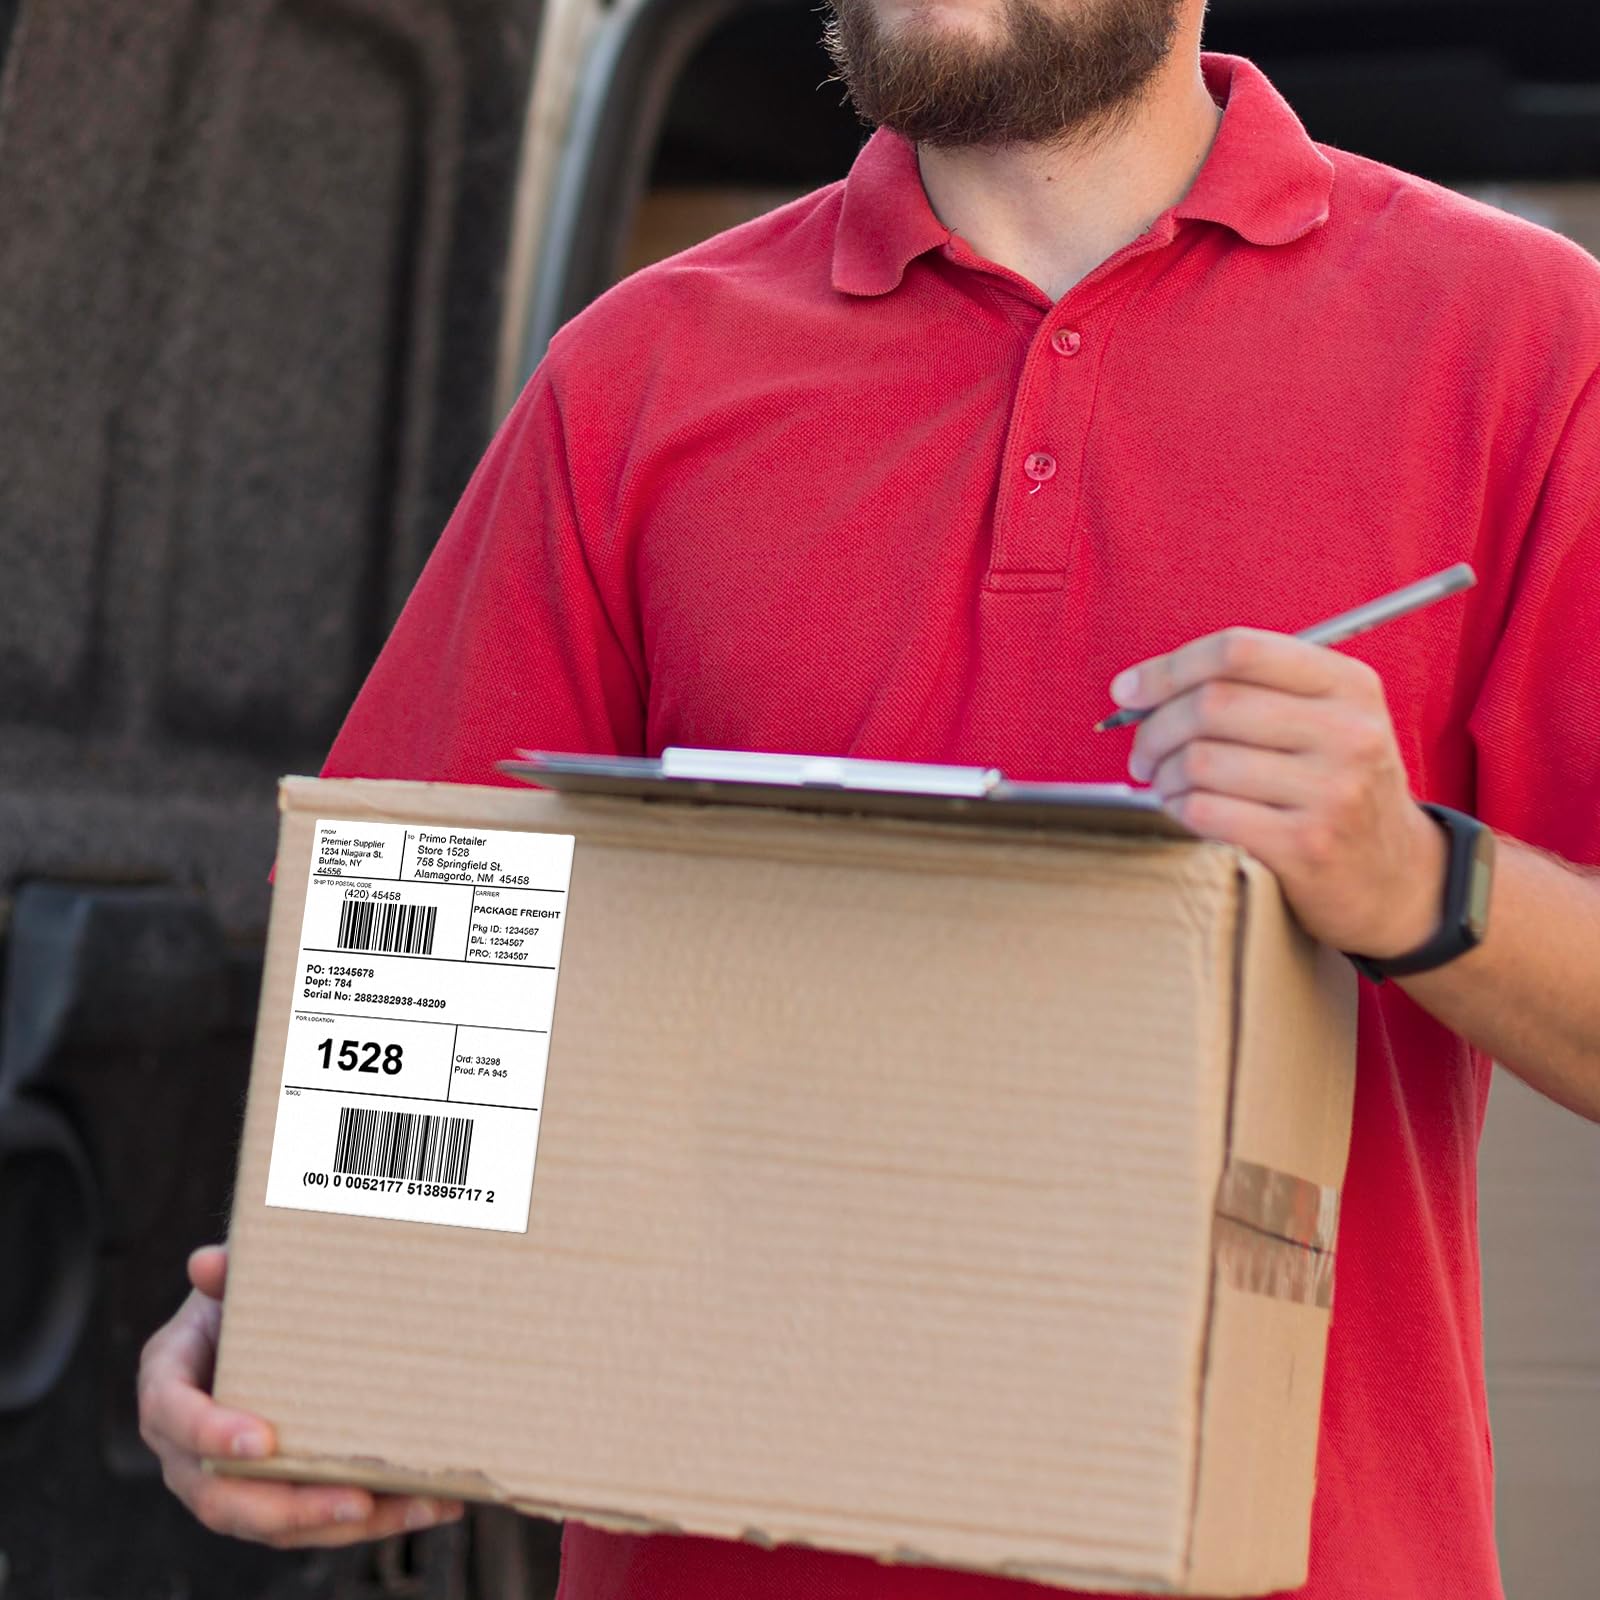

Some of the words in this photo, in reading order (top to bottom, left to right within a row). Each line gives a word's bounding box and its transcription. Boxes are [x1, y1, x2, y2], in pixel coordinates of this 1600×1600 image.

[321, 837, 351, 847] Premier
[353, 839, 385, 849] Supplier
[419, 833, 446, 844] Primo
[449, 835, 487, 847] Retailer
[321, 848, 339, 856] 1234
[341, 849, 371, 858] Niagara
[418, 845, 443, 855] Store
[447, 847, 470, 857] 1528
[319, 857, 347, 866] Buffalo,
[349, 858, 362, 867] NY
[416, 857, 434, 867] 758
[436, 858, 487, 871] Springfield
[490, 862, 502, 871] St.
[317, 867, 342, 875] 44556
[414, 869, 474, 882] Alamagordo,
[477, 874, 494, 883] NM
[499, 875, 530, 885] 45458
[344, 888, 369, 901] (420)
[372, 891, 401, 900] 45458
[475, 890, 500, 898] CARRIER
[473, 906, 518, 916] PACKAGE
[520, 909, 561, 919] FREIGHT
[472, 923, 488, 935] Pkg
[490, 924, 502, 933] ID:
[471, 936, 486, 945] B/L:
[469, 948, 491, 959] PRO:
[306, 964, 325, 975] PO:
[328, 966, 374, 978] 12345678
[305, 976, 331, 988] Dept:
[334, 978, 352, 988] 784
[303, 988, 332, 1001] Serial
[334, 990, 352, 1002] No:
[354, 992, 447, 1009] 2882382938-48209
[317, 1038, 403, 1076] 1528
[455, 1054, 473, 1065] Ord:
[475, 1055, 501, 1066] 33298
[454, 1066, 475, 1076] Prod:
[478, 1067, 490, 1077] FA
[492, 1069, 508, 1078] 945
[302, 1172, 329, 1188] (00)
[333, 1174, 341, 1187] 0
[346, 1176, 403, 1193] 0052177
[407, 1182, 481, 1201] 513895717
[486, 1190, 495, 1203] 2
